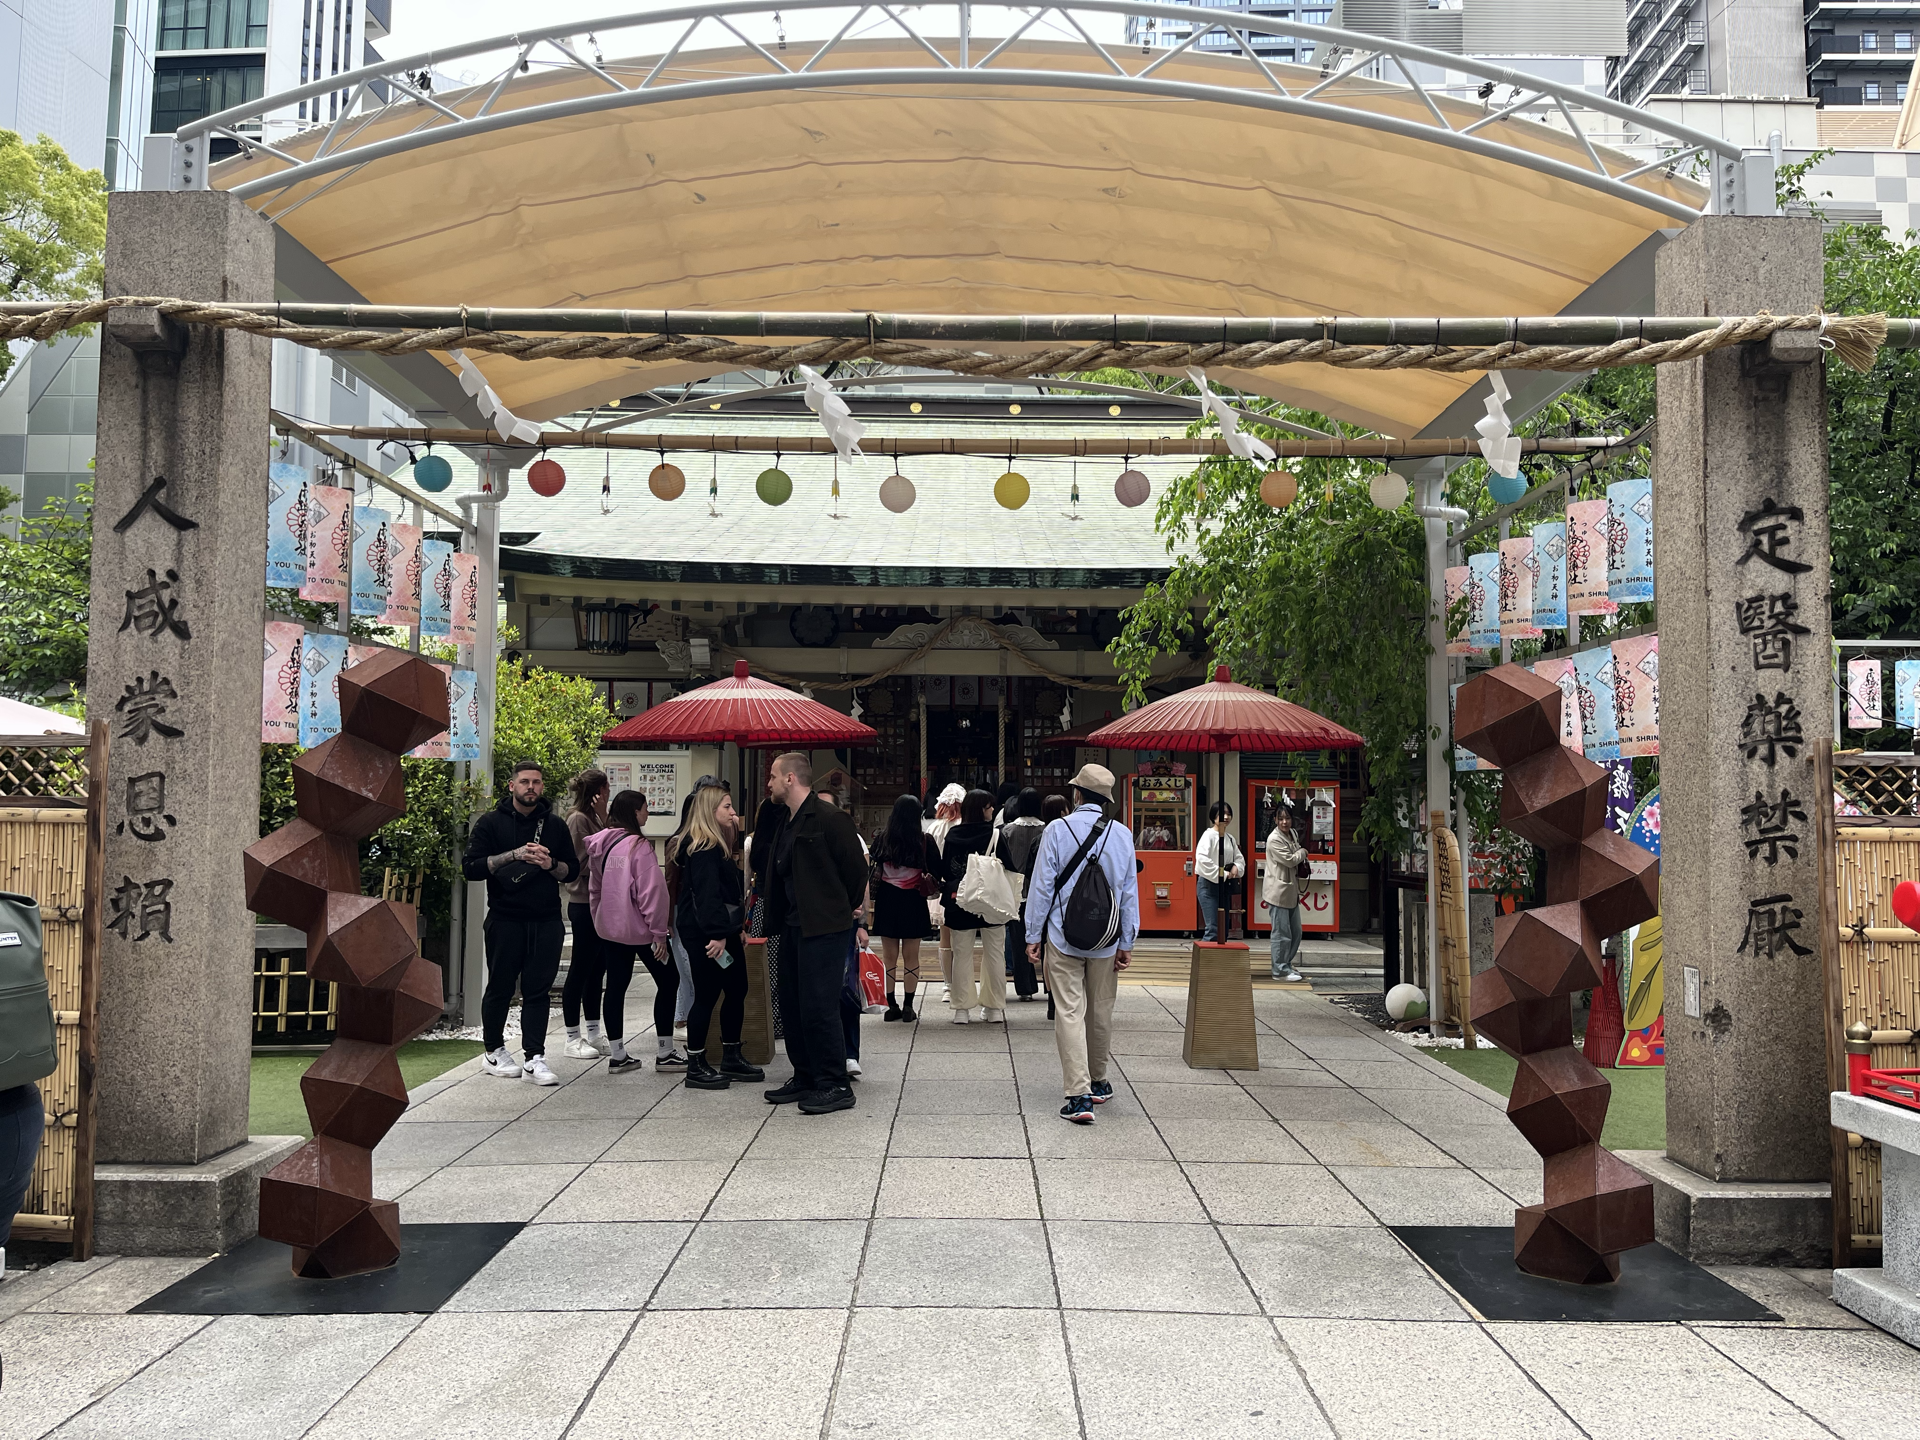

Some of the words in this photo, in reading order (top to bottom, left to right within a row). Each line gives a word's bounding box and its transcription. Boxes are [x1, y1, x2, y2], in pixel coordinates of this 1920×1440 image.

[274, 561, 291, 569] YOU
[1625, 576, 1653, 584] SHRINE
[1588, 590, 1608, 598] SHRIN
[264, 720, 281, 728] YOU
[1636, 734, 1658, 743] SHRIN
[1599, 740, 1619, 748] SHRIN
[1141, 778, 1183, 788] おみくじ
